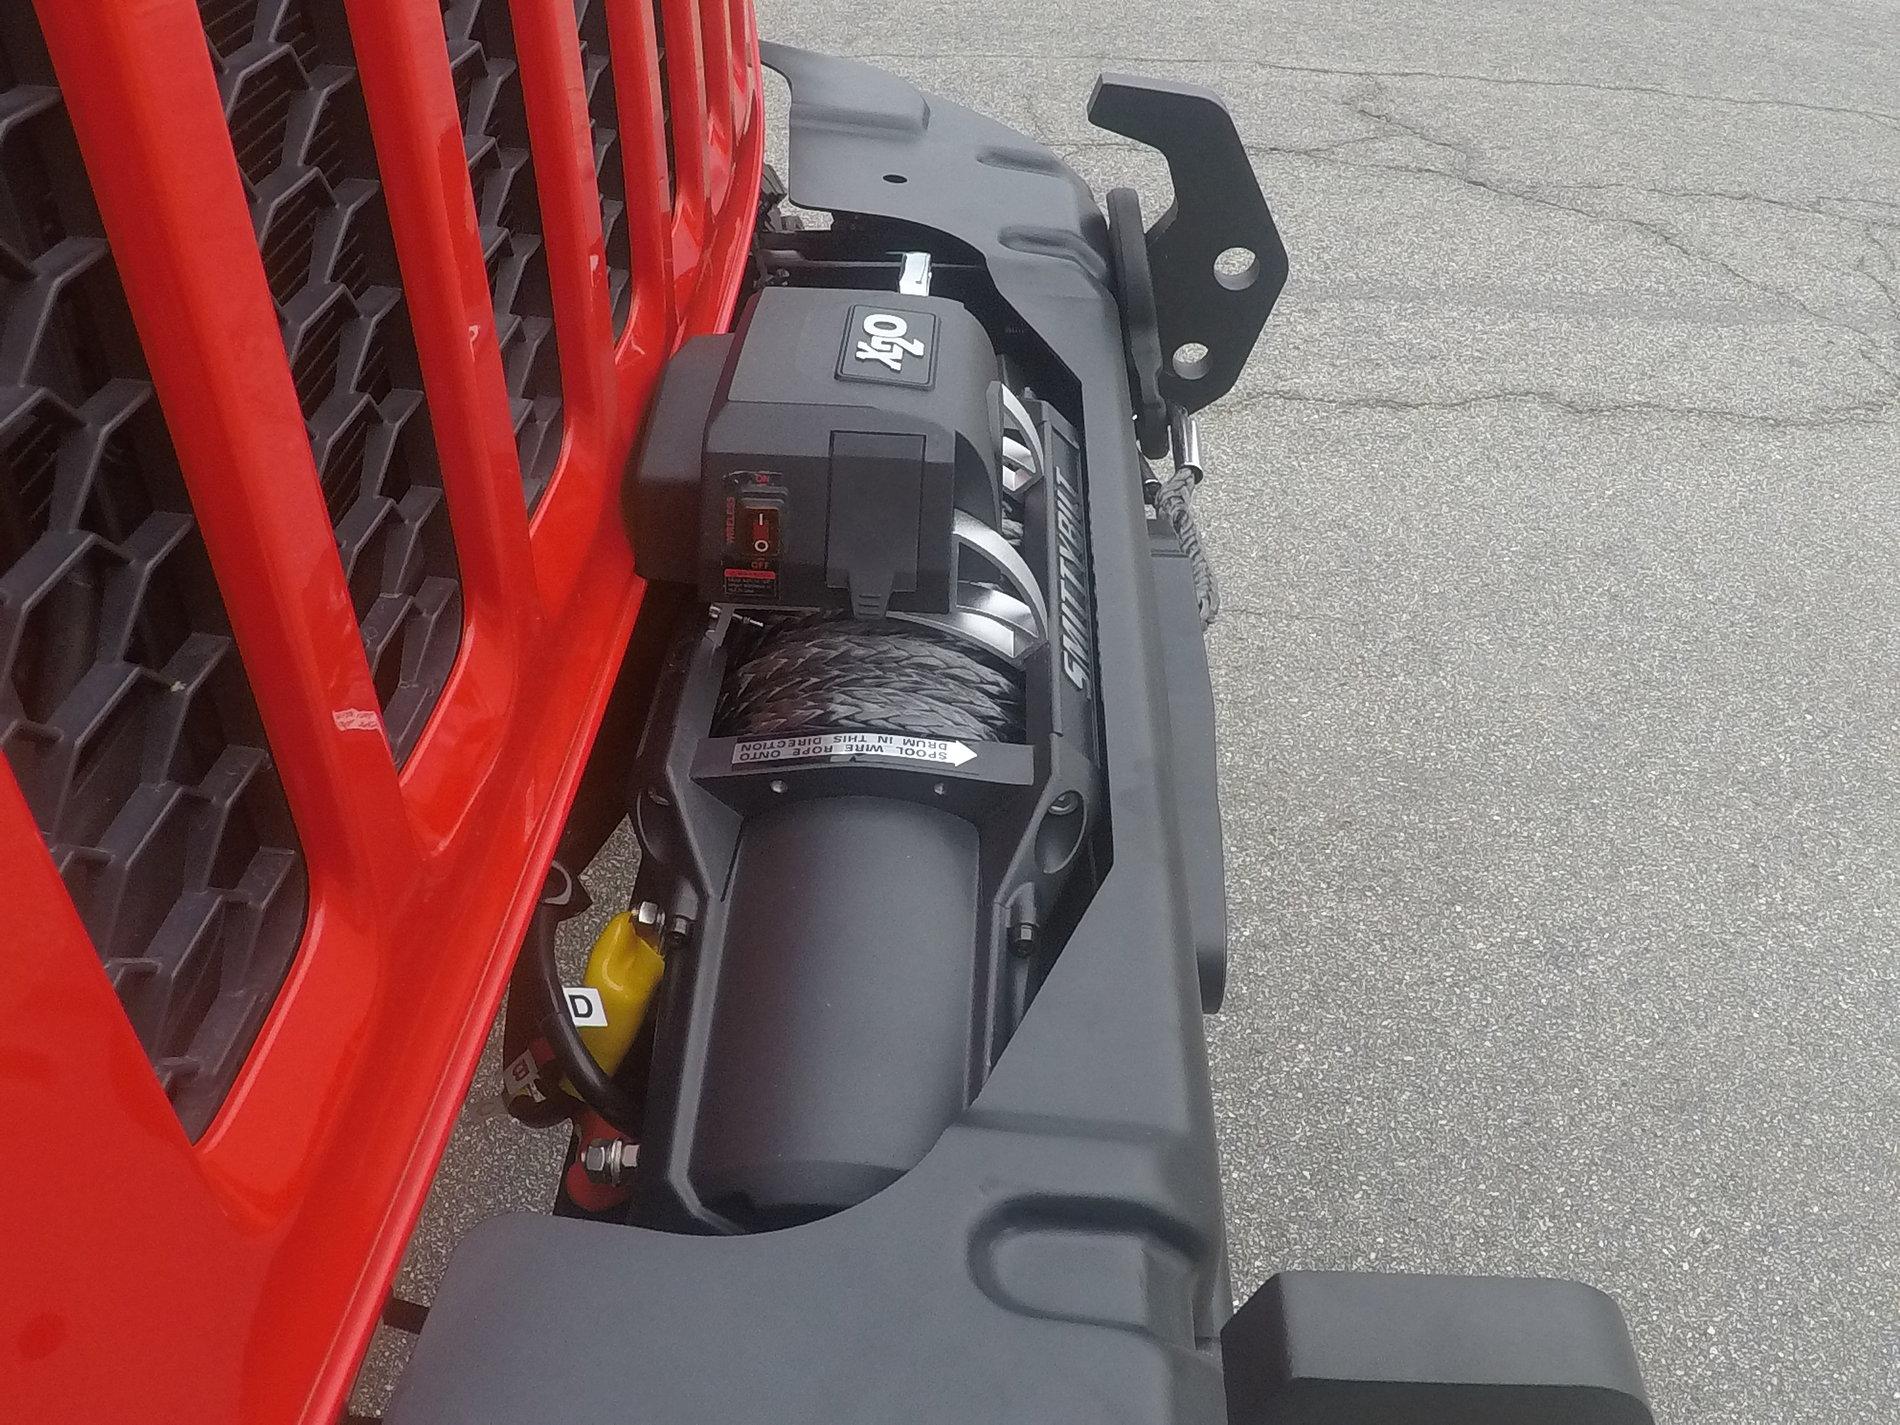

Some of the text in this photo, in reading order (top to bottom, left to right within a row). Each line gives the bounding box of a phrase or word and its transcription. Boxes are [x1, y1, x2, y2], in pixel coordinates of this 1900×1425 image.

[751, 561, 769, 570] OFF
[1055, 466, 1090, 691] SMITTYBILT
[740, 743, 948, 761] SPOOL WIRE ROPE ONTO
[741, 735, 948, 752] DRUM IN THIS DIRECTION
[568, 994, 594, 1019] D
